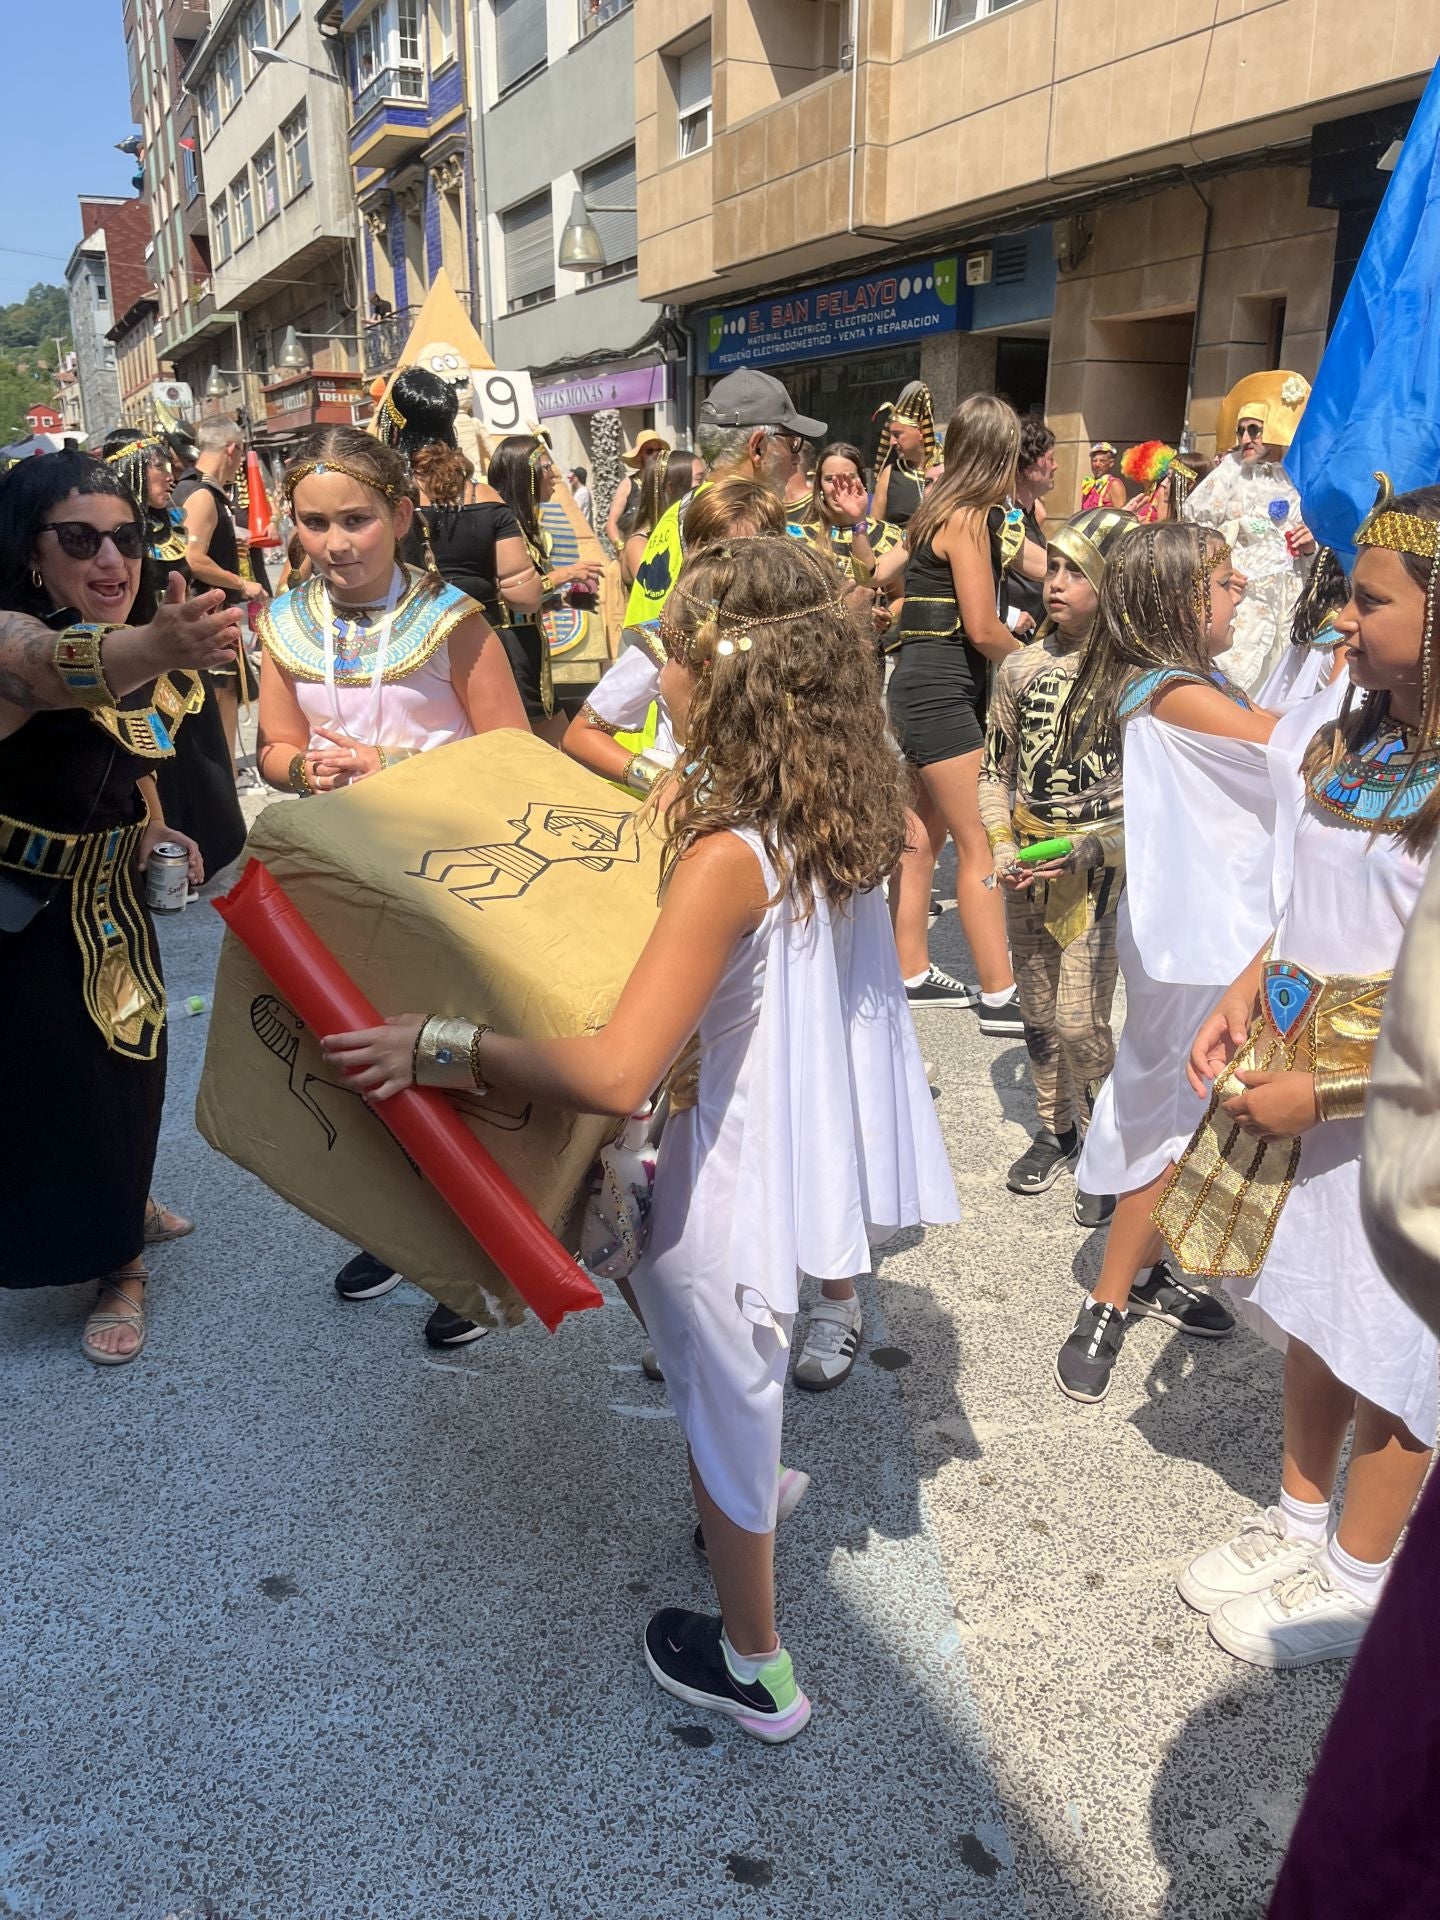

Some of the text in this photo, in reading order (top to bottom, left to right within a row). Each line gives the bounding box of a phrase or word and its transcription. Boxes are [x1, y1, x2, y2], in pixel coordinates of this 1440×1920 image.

[747, 332, 782, 346] MATERIAL
[783, 322, 828, 339] ELECTRICO
[834, 308, 897, 329] ELECTRONICA
[748, 278, 897, 333] E. SAN PELAYO
[719, 348, 752, 364] PEQUEÑO
[752, 334, 832, 357] ELECTRODOMESTICO
[840, 328, 866, 341] VENTA
[868, 327, 875, 336] Y
[877, 314, 940, 335] REPARACION
[485, 376, 520, 430] 9
[566, 383, 603, 406] MONAS
